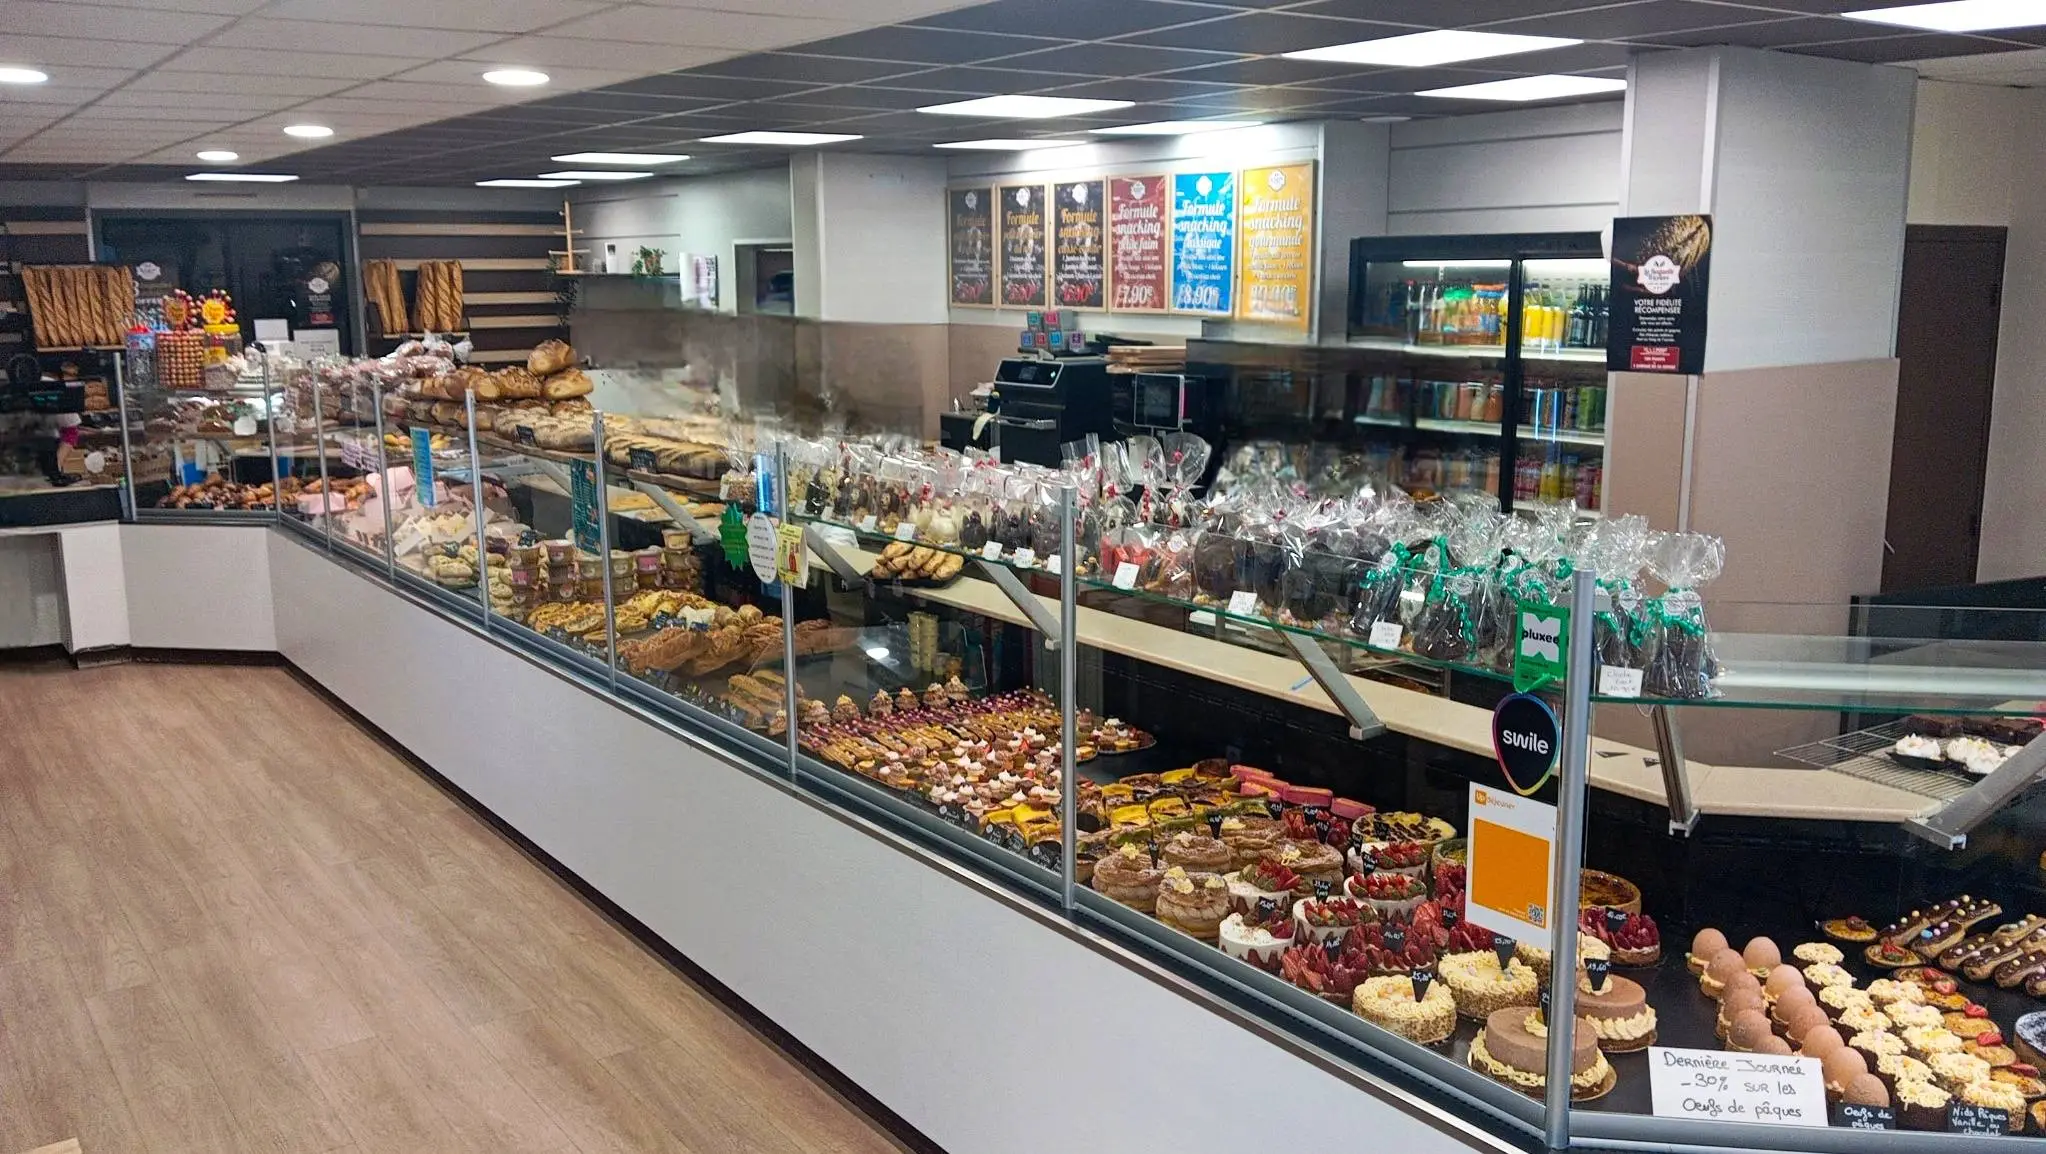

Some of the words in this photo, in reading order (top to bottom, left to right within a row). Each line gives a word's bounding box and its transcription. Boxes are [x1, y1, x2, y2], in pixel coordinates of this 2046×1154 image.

[1006, 210, 1040, 224] Formule
[1061, 208, 1098, 223] Formule
[1118, 203, 1159, 219] Formule
[1182, 200, 1225, 217] Formule
[1116, 220, 1161, 239] snacking
[1178, 218, 1228, 236] snacking
[1250, 215, 1303, 231] snacking
[1634, 299, 1655, 307] VOTRE
[1521, 629, 1561, 646] pluxee
[1502, 729, 1549, 754] swile
[1681, 1073, 1729, 1093] -30%
[1777, 1081, 1797, 1096] les
[1727, 1099, 1746, 1114] de
[1754, 1101, 1802, 1121] pâques
[1877, 1109, 1893, 1120] de
